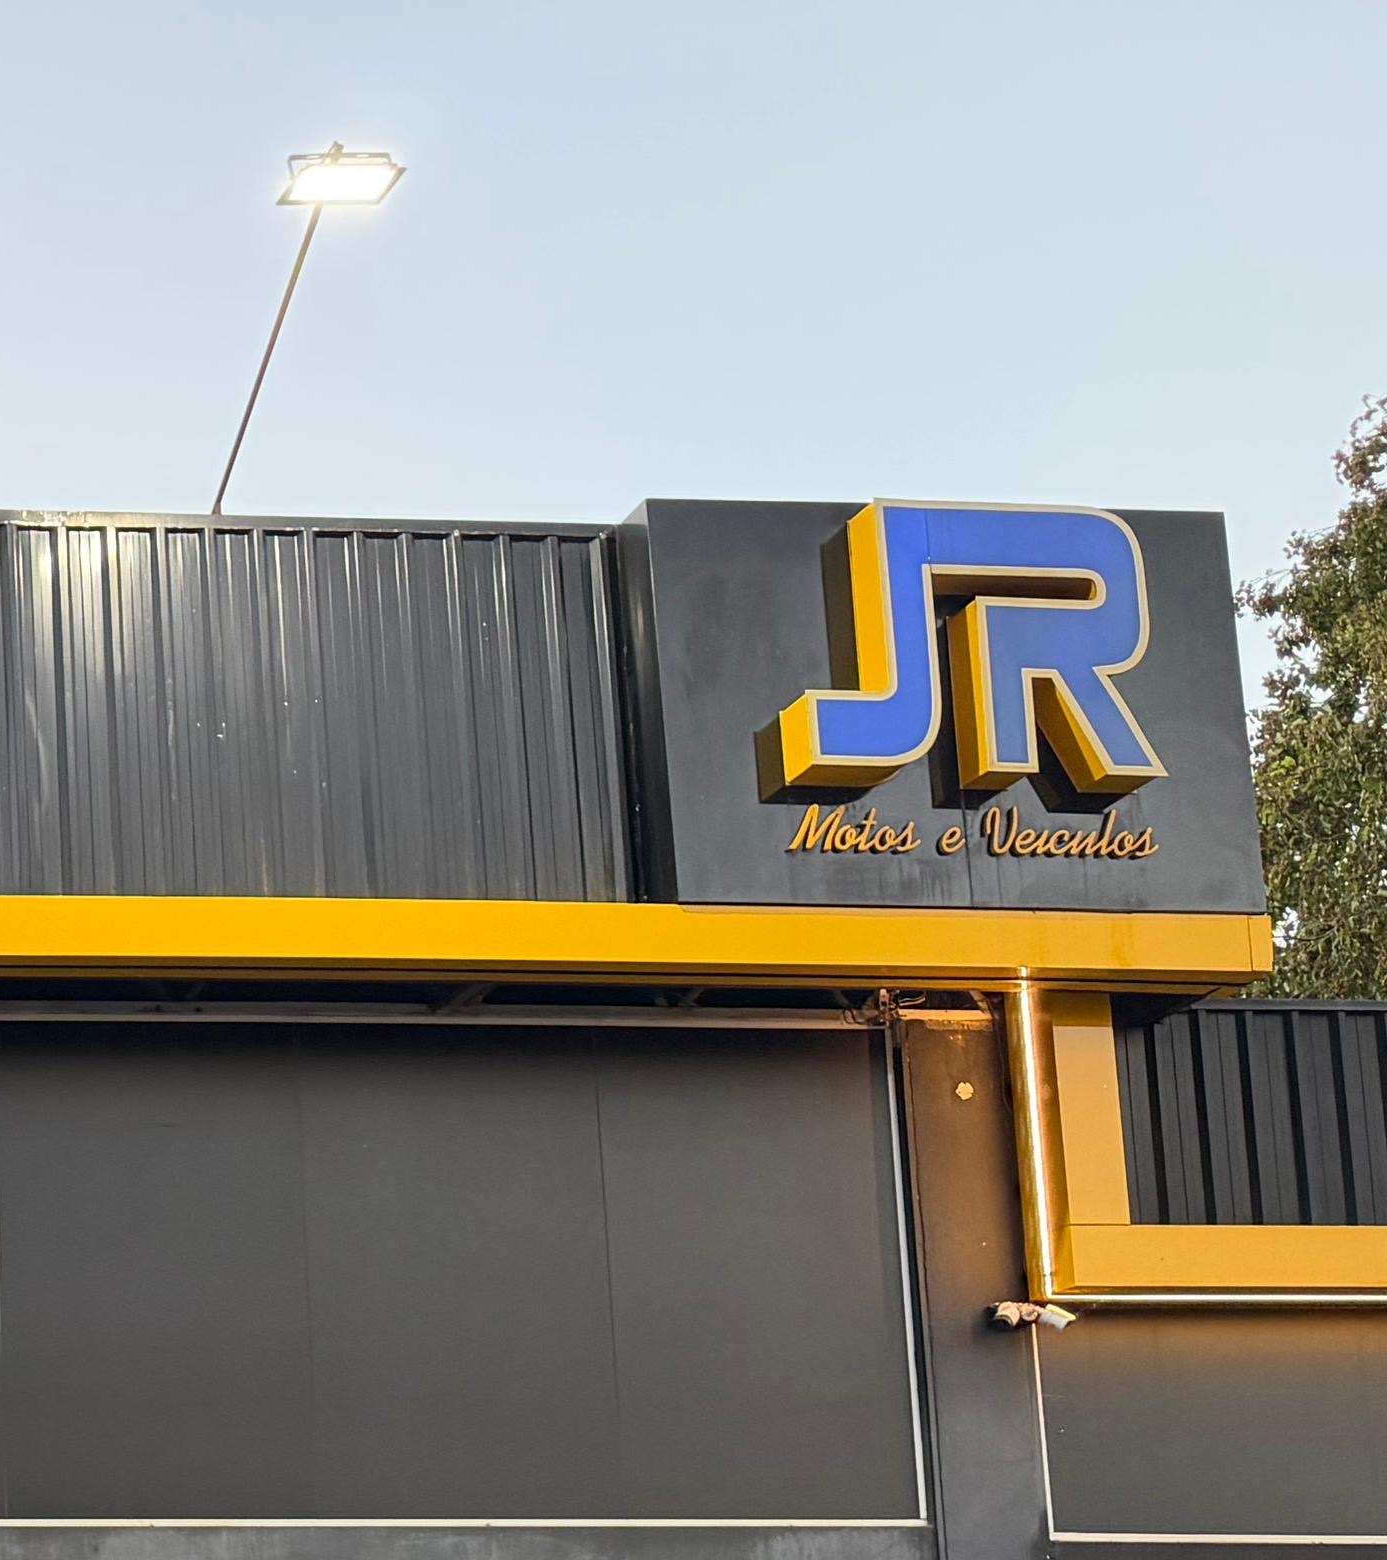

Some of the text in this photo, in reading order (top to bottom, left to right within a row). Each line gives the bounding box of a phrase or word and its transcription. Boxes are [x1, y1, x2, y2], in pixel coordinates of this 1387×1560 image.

[780, 498, 1168, 794] JR
[789, 803, 922, 852] Motos
[939, 825, 967, 853] e
